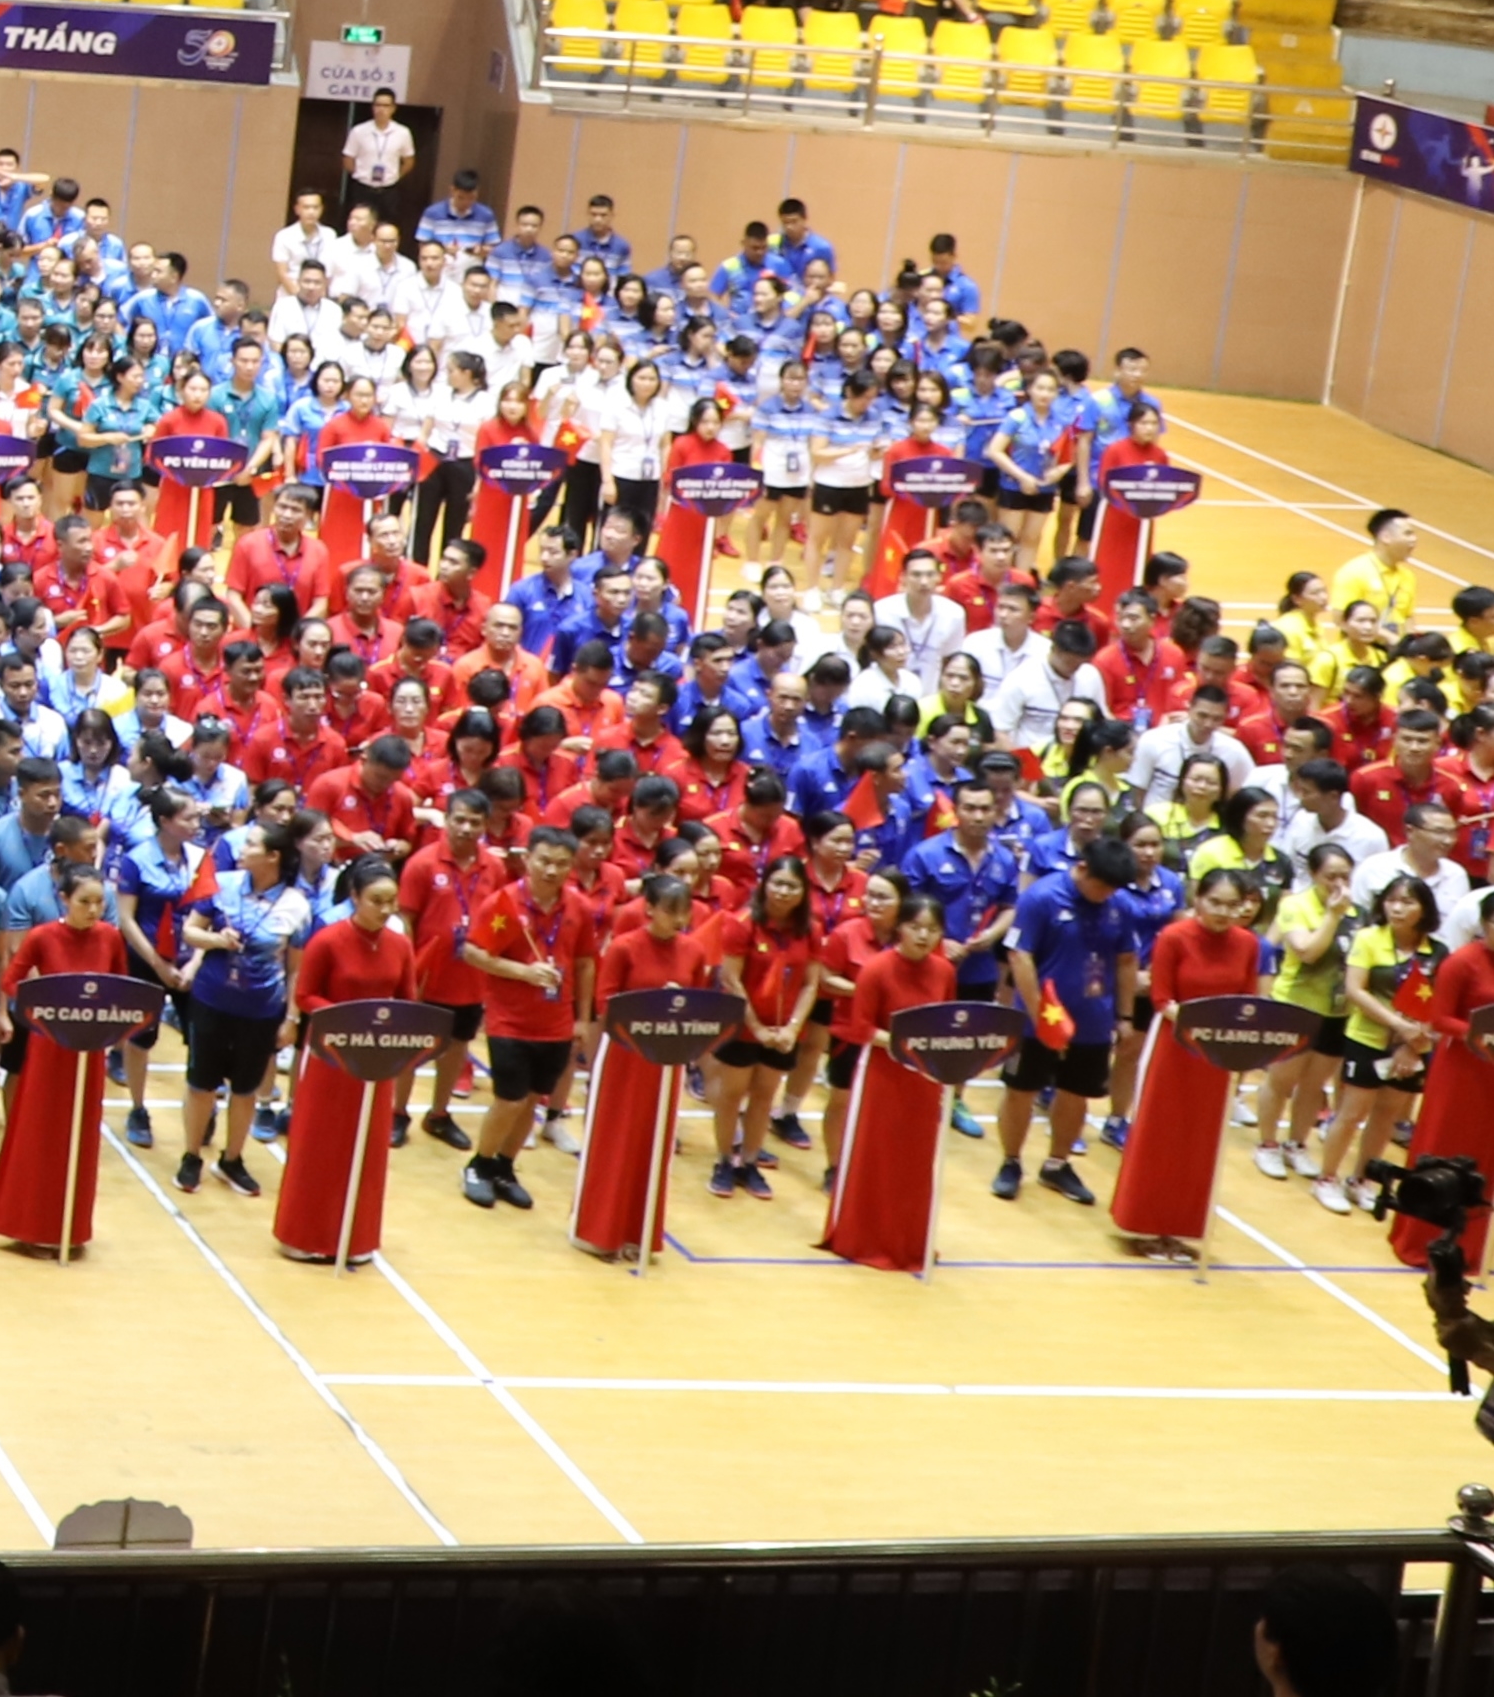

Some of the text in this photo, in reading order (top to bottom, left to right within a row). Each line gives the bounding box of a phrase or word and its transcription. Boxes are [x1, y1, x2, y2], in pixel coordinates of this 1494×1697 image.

[3, 18, 117, 56] THẮNG
[320, 64, 357, 82] CỬA
[386, 71, 396, 83] 3
[328, 84, 372, 97] GATE
[32, 1004, 145, 1023] PC CAO BẰNG
[324, 1031, 436, 1049] PC HÀ GIANG
